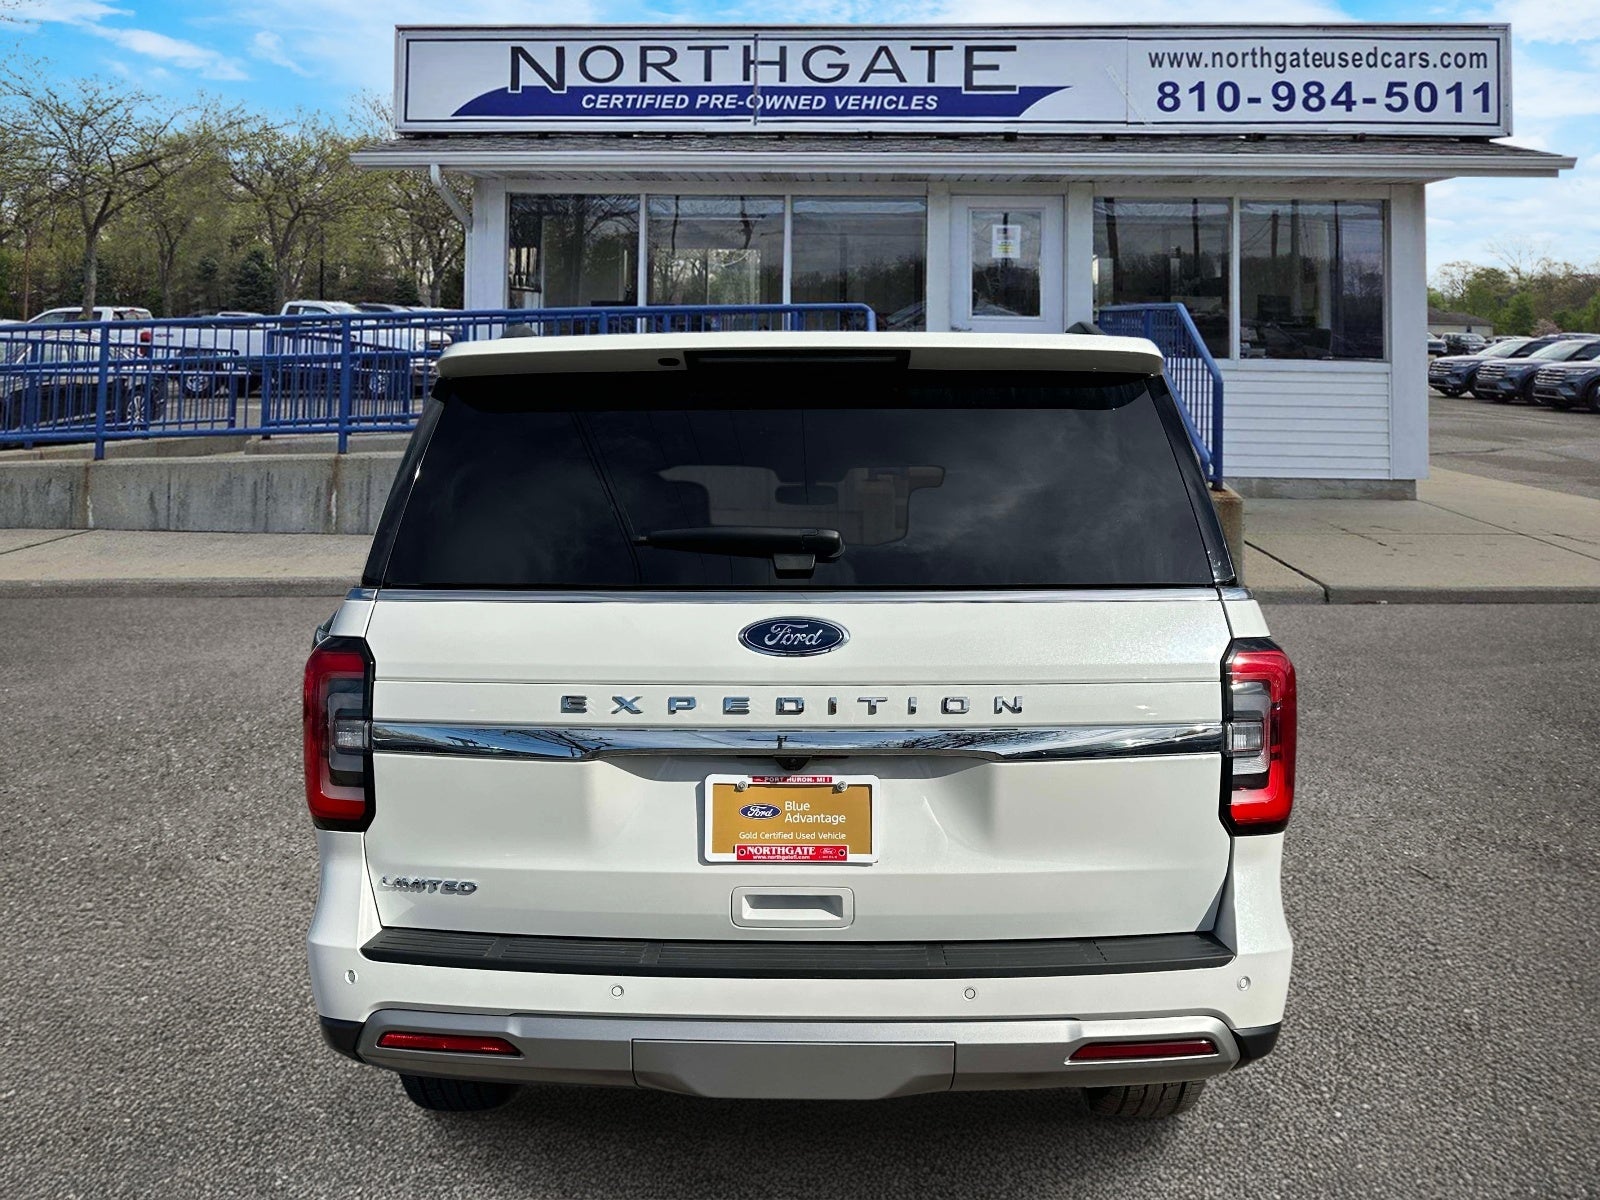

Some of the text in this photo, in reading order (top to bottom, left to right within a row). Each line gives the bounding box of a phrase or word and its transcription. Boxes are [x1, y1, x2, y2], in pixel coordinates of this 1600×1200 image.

[1149, 46, 1488, 74] www.northgateusedcars.com
[509, 45, 1018, 94] NORTHGATE
[581, 94, 939, 111] CERTIFIED PRE-OWNED VEHICLES
[1156, 81, 1491, 114] 810-984-5011
[763, 622, 823, 646] Ford
[559, 694, 1024, 717] EXPEDITION
[746, 805, 773, 818] Ford
[784, 800, 811, 812] Blue
[784, 812, 847, 826] Advantage
[739, 831, 847, 840] Gold Certified Used Vehicle
[746, 846, 817, 856] NORTHGATE
[380, 876, 478, 896] LIMITED
